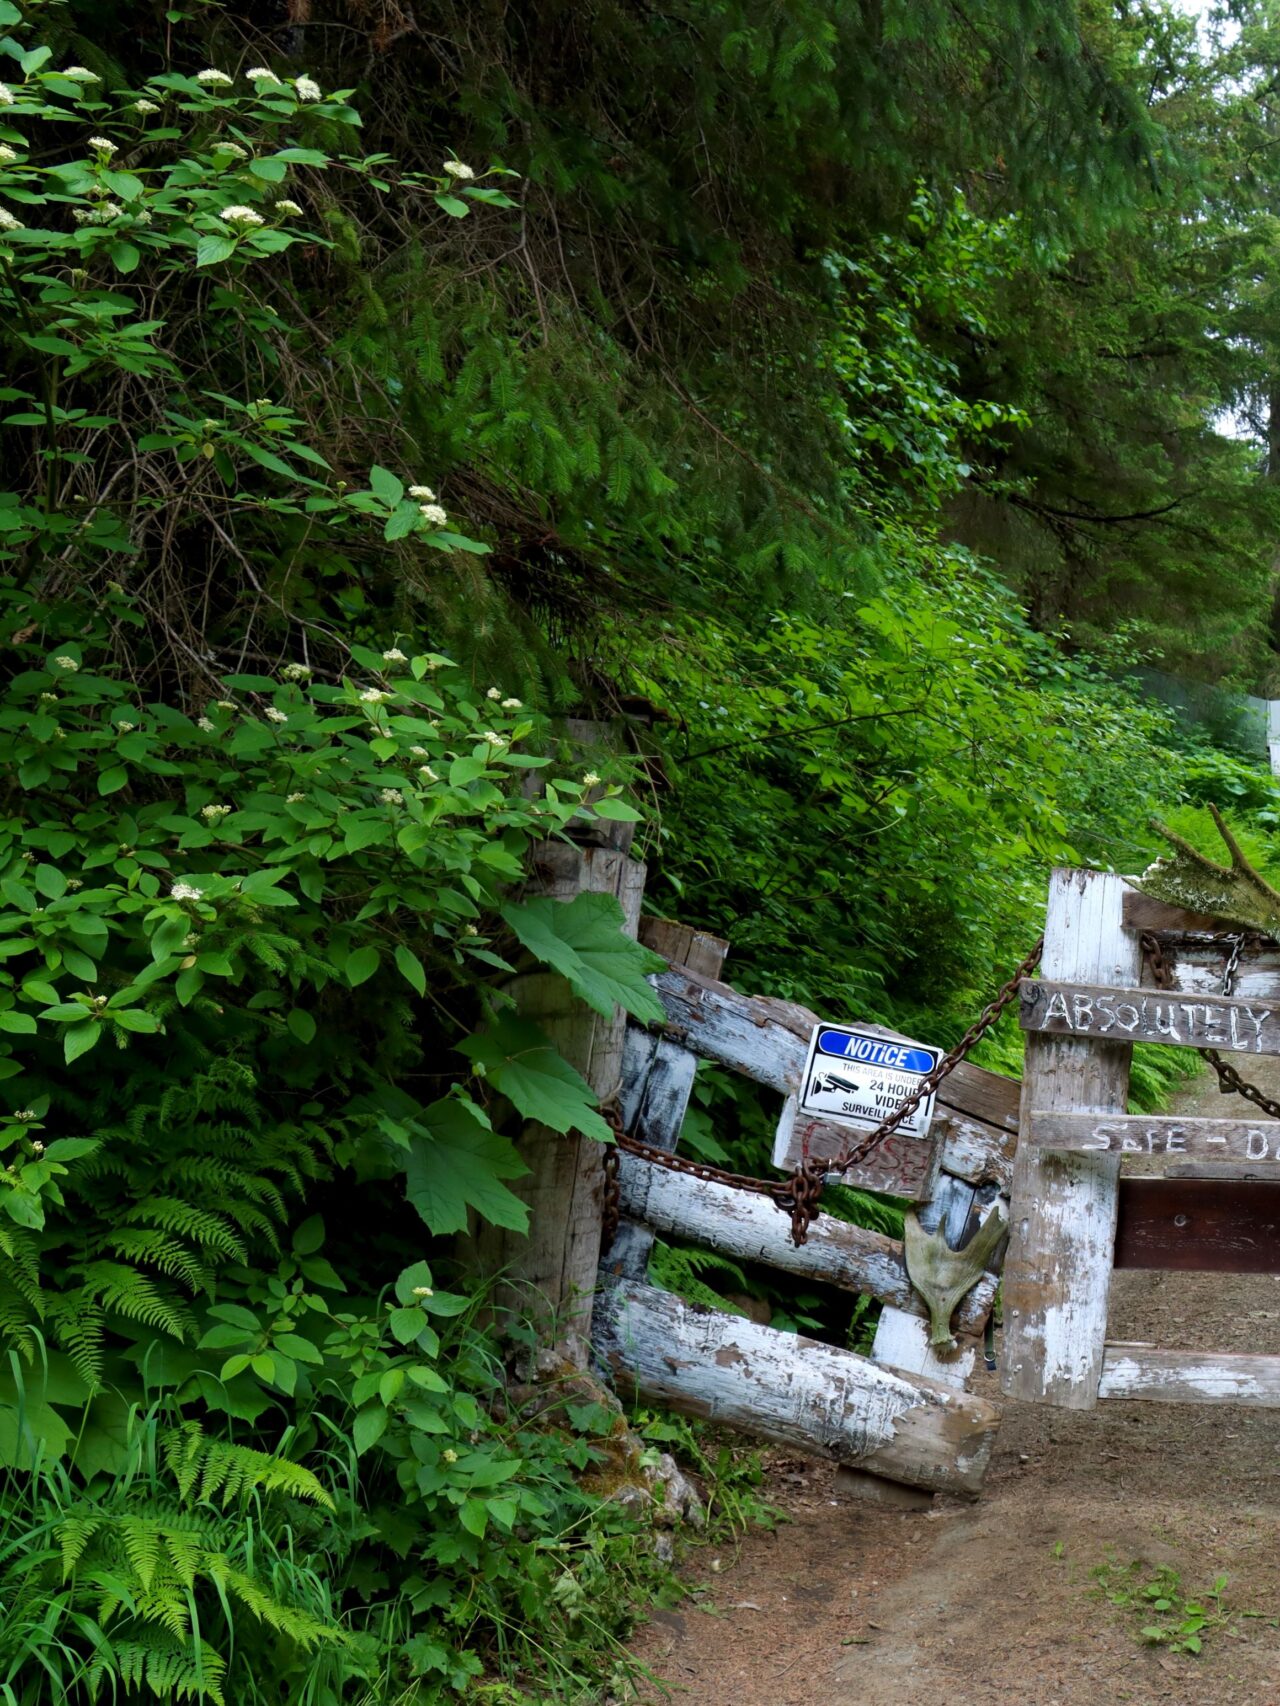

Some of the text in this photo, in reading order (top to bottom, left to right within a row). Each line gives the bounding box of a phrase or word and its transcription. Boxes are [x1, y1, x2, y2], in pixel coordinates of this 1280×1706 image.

[1038, 992, 1271, 1053] ABSOLUTELY
[844, 1038, 911, 1067] NOTICE
[842, 1062, 861, 1075] THIS
[862, 1066, 883, 1079] AREA
[885, 1071, 894, 1082] IS
[869, 1079, 884, 1092] 24
[875, 1094, 909, 1111] VIDE
